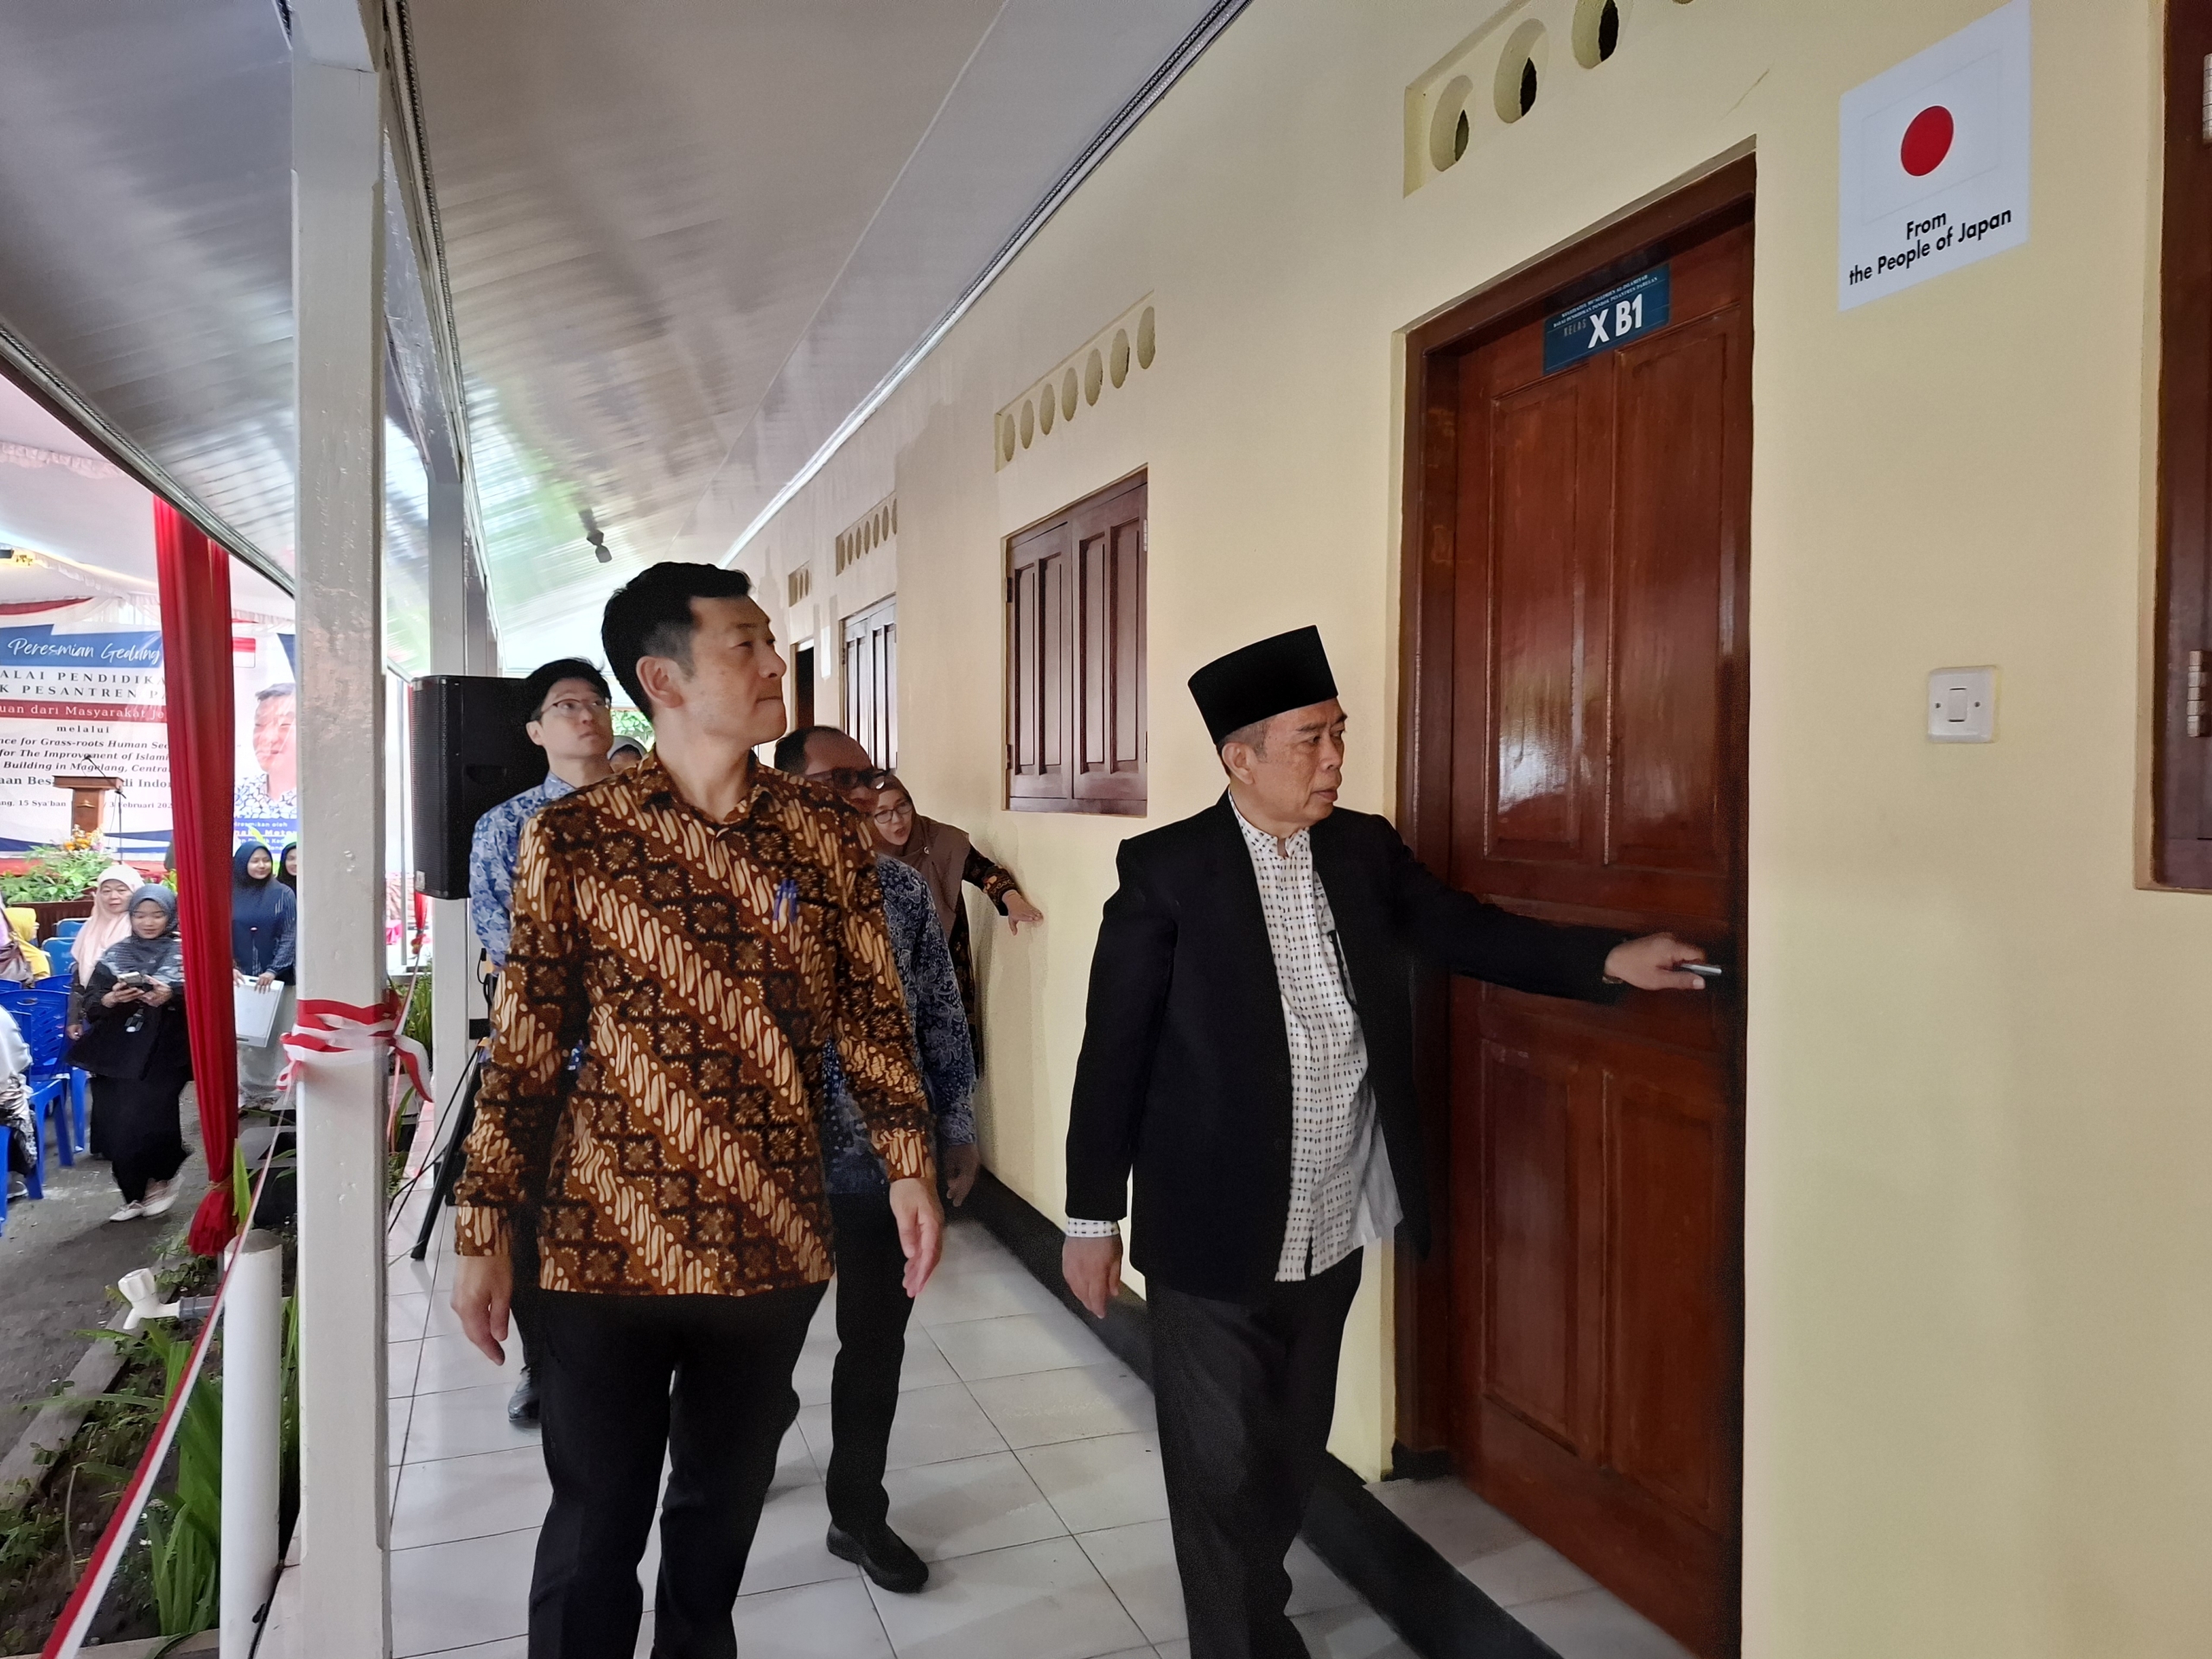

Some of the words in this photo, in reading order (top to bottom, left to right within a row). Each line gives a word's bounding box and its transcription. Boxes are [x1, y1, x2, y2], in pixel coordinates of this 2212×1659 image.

[1906, 213, 1947, 240] From
[1848, 264, 1872, 285] the
[1878, 239, 1930, 274] People
[1936, 226, 1954, 251] of
[1957, 209, 2012, 243] Japan
[1563, 318, 1587, 337] KELAS
[1587, 308, 1610, 349] X
[1615, 293, 1643, 337] B1
[8, 638, 94, 658] Peresmian
[100, 642, 160, 664] Gedung
[22, 684, 137, 698] PESANTREN
[30, 704, 59, 715] dari
[66, 705, 145, 719] Masyarakat
[56, 724, 110, 734] melalui
[20, 737, 37, 747] for
[41, 738, 104, 747] Grass-roots
[107, 740, 148, 749] Human
[121, 753, 133, 761] of
[3, 761, 52, 772] Building
[131, 764, 169, 772] Centra
[28, 776, 52, 785] Bes
